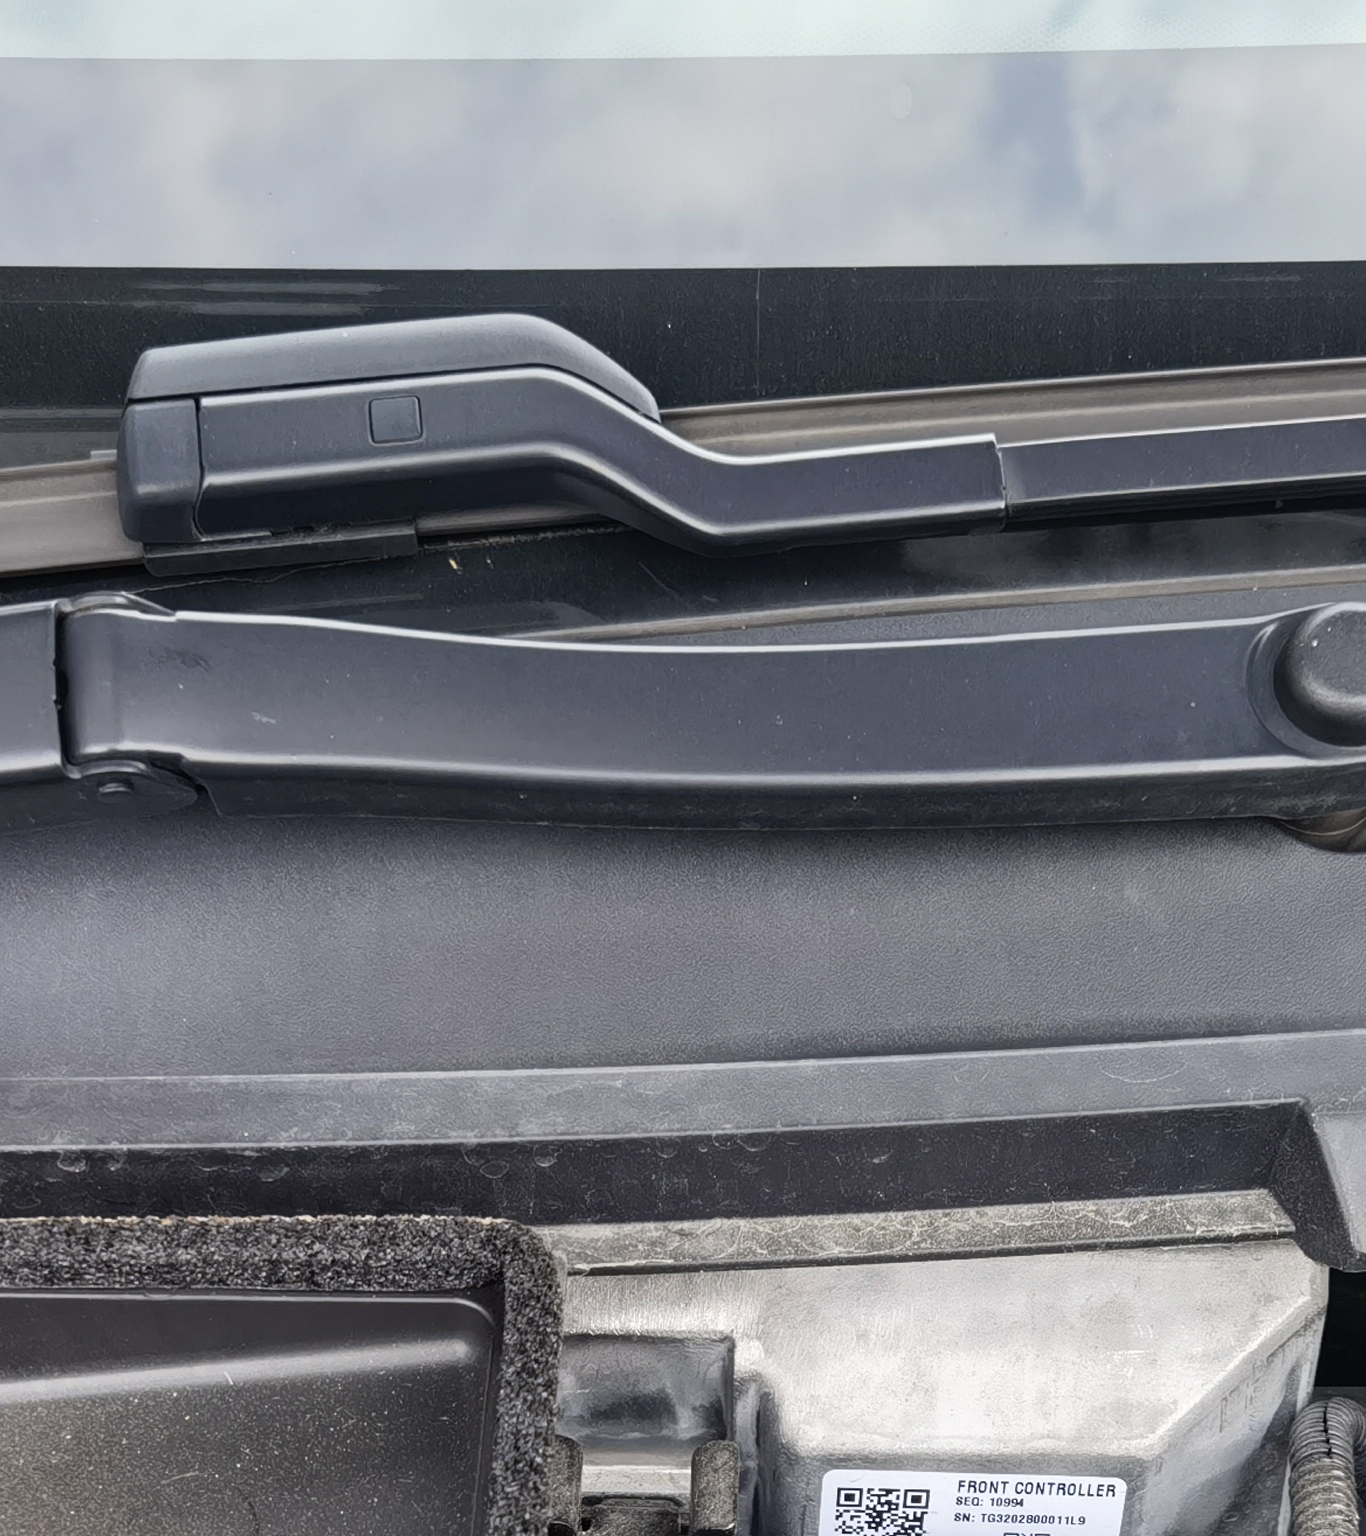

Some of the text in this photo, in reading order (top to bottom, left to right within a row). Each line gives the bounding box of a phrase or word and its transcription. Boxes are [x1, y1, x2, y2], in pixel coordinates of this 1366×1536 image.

[957, 1480, 1116, 1498] FRONT CONTROLLER
[955, 1496, 1024, 1508] SEQ: 10994
[953, 1512, 1086, 1525] SN: TG3202800011L9
